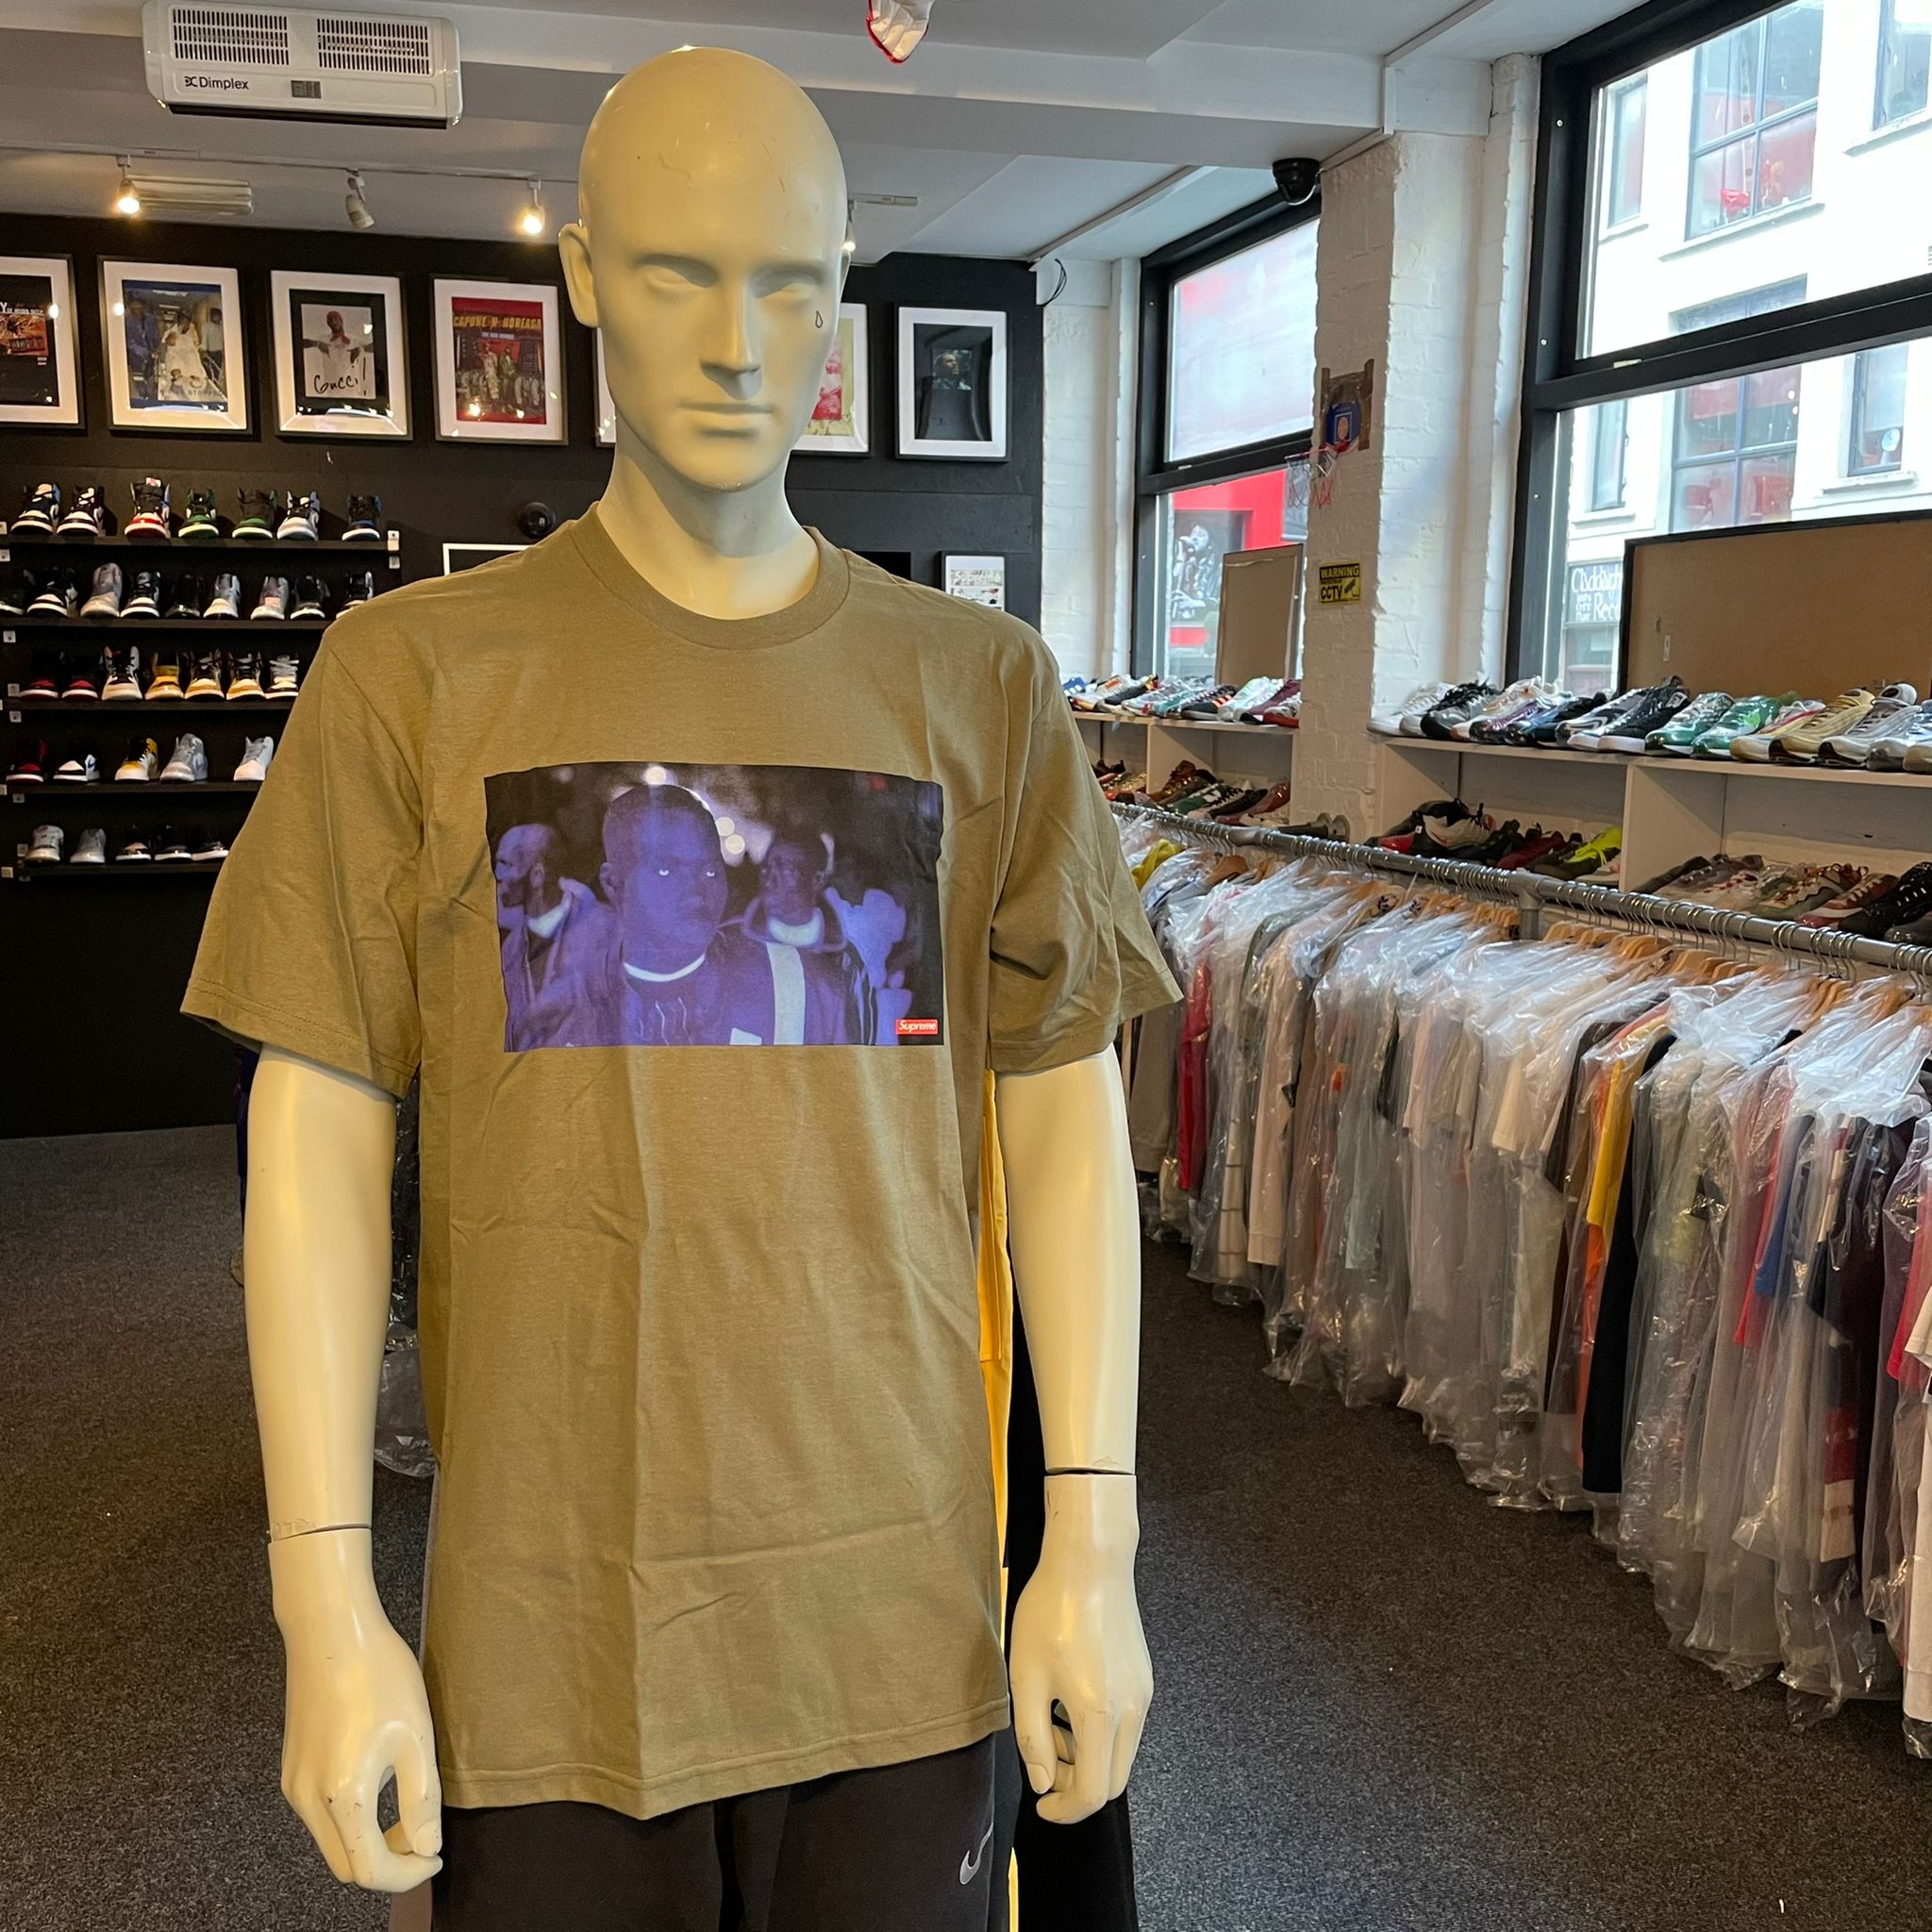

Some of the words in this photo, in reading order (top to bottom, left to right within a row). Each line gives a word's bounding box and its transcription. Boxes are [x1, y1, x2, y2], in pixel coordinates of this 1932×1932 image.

[199, 76, 249, 91] Dimplex
[454, 315, 487, 327] CAPONE
[1321, 565, 1359, 579] WARNING
[1321, 585, 1342, 600] CCTV
[898, 1020, 936, 1033] Supreme
